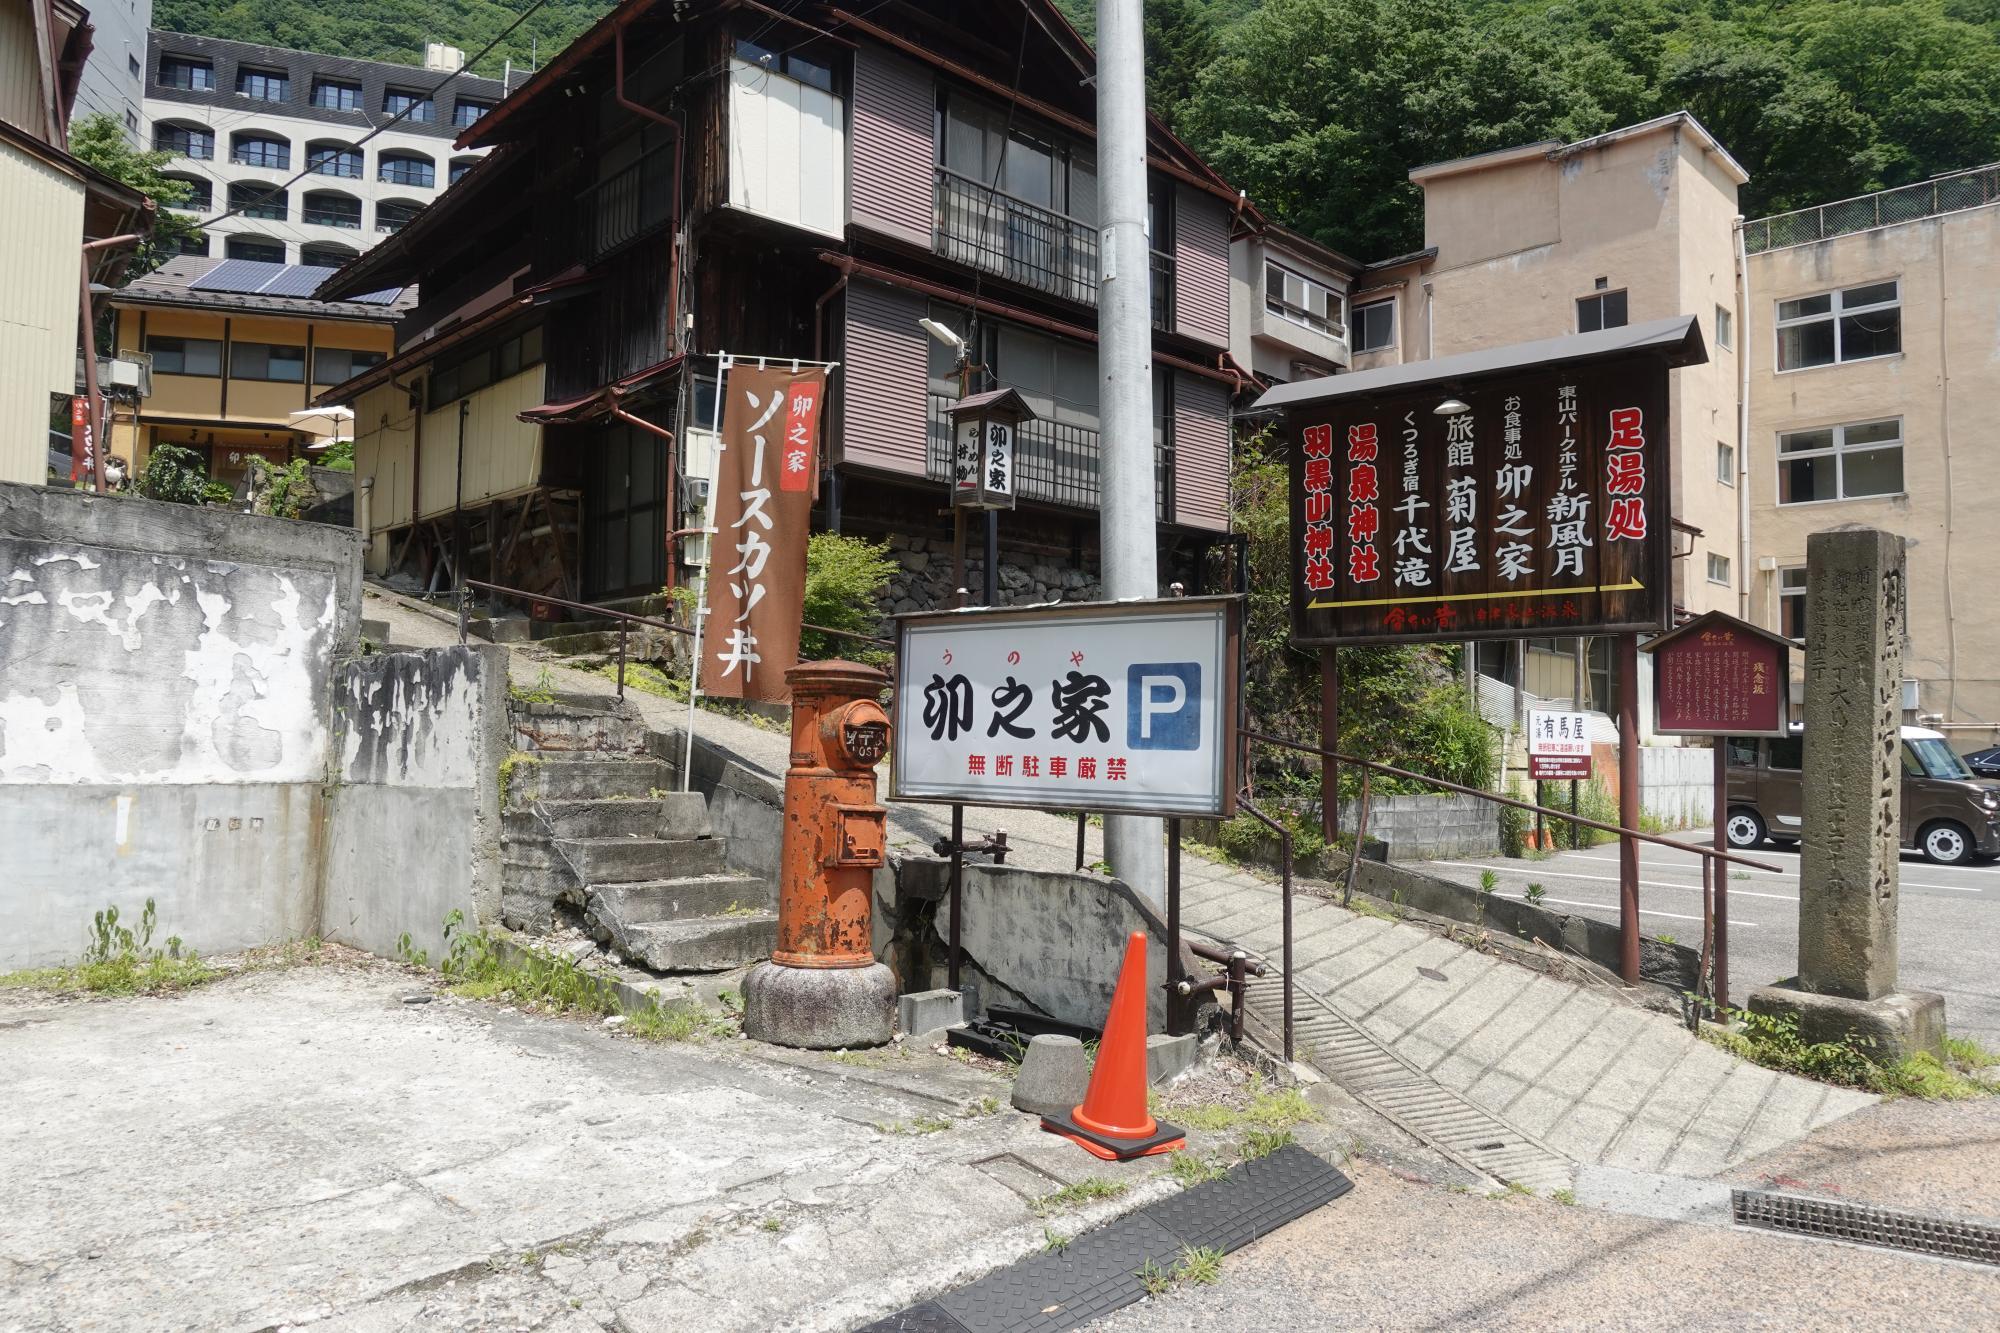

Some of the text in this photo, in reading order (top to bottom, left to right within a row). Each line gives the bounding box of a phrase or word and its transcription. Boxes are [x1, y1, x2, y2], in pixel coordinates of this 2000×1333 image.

[787, 394, 813, 474] 卯之家
[968, 428, 979, 475] らーめん
[989, 424, 1007, 490] 卯之家
[1495, 395, 1536, 581] お食事処 卯之家
[1546, 385, 1593, 577] 東山パークホテル 新風月
[1605, 406, 1647, 542] 足湯処
[717, 390, 785, 684] ソースカツ丼
[1302, 424, 1335, 591] 羽黒山神社
[1348, 423, 1379, 584] 湯泉神社
[1392, 410, 1431, 588] くつろぎ宿 千代滝
[1443, 414, 1481, 573] 旅館 菊屋
[923, 670, 1111, 742] 卯之家
[1141, 675, 1187, 738] P
[1544, 714, 1584, 739] 有馬屋
[1752, 662, 1765, 695] 残念坂
[968, 754, 1128, 781] 無断駐車厳禁
